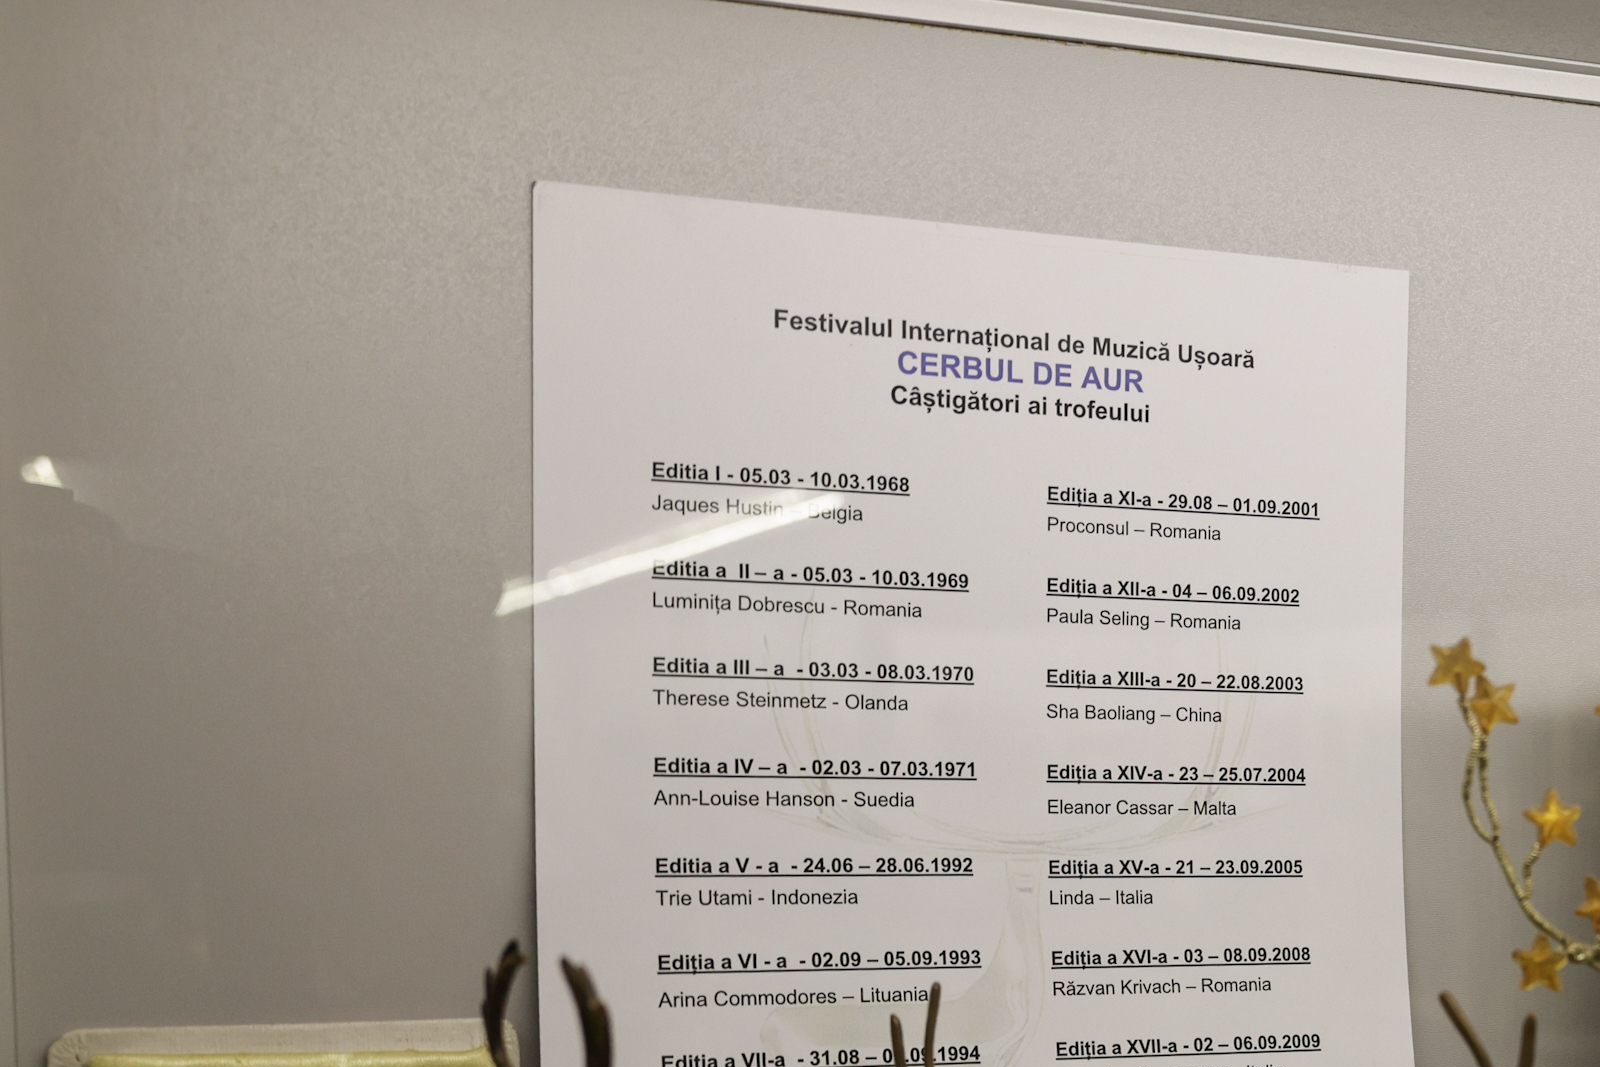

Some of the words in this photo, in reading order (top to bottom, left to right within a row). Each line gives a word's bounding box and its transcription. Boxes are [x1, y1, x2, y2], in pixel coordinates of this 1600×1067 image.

[774, 307, 892, 341] Festivalul
[1058, 333, 1084, 356] de
[1093, 335, 1170, 364] Muzică
[898, 350, 1023, 386] CERBUL
[1034, 361, 1072, 390] DE
[1081, 365, 1143, 395] AUR
[1028, 395, 1047, 418] ai
[1055, 397, 1149, 425] trofeului
[810, 470, 909, 494] 10.03.1968
[652, 495, 719, 516] Jaques
[1118, 489, 1151, 510] XI-a
[1168, 492, 1212, 513] 29.08
[1233, 497, 1317, 517] 01.09.2001
[1048, 515, 1128, 538] Proconsul
[1150, 522, 1220, 541] Romania
[803, 565, 853, 586] 05.03
[872, 568, 968, 590] 10.03.1969
[1117, 580, 1156, 600] XII-a
[1212, 585, 1299, 604] 06.09.2002
[739, 594, 824, 615] Dobrescu
[844, 599, 922, 618] Romania
[1047, 607, 1093, 627] Paula
[1100, 609, 1149, 632] Seling
[1171, 611, 1240, 632] Romania
[734, 659, 749, 679] III
[809, 661, 858, 681] 03.03
[877, 662, 974, 683] 08.03.1970
[1117, 670, 1160, 689] XIII-a
[1217, 673, 1303, 691] 22.08.2003
[653, 688, 729, 709] Therese
[736, 690, 826, 711] Steinmetz
[845, 693, 908, 712] Olanda
[1047, 702, 1078, 721] Sha
[1085, 704, 1155, 725] Baoliang
[1176, 706, 1221, 723] China
[812, 758, 861, 778] 02.03
[880, 760, 974, 779] 07.03.1971
[1118, 764, 1162, 782] XIV-a
[1219, 766, 1306, 784] 25.07.2004
[654, 789, 759, 808] Ann-Louise
[766, 790, 834, 808] Hanson
[854, 790, 914, 808] Suedia
[1048, 798, 1111, 816] Eleanor
[1116, 798, 1174, 817] Cassar
[1194, 800, 1236, 817] Malta
[804, 856, 853, 875] 24.06
[876, 856, 973, 874] 28.06.1992
[1119, 859, 1159, 876] XV-a
[1216, 858, 1302, 875] 23.09.2005
[656, 888, 692, 908] Trie
[699, 888, 752, 907] Utami
[772, 887, 858, 907] Indonezia
[1050, 889, 1094, 906] Linda
[1116, 889, 1153, 906] Italia
[812, 951, 861, 970] 02.09
[884, 948, 981, 968] 05.09.1993
[1123, 948, 1167, 966] XVI-a
[1224, 946, 1310, 964] 08.09.2008
[659, 990, 707, 1009] Arina
[714, 988, 837, 1008] Commodores
[860, 987, 929, 1003] Lituania
[1053, 980, 1115, 998] Răzvan
[1121, 978, 1180, 996] Krivach
[1202, 975, 1271, 994] Romania
[1127, 1038, 1177, 1056] XVII-a
[1234, 1033, 1320, 1052] 06.09.2009
[810, 1048, 859, 1067] 31.08
